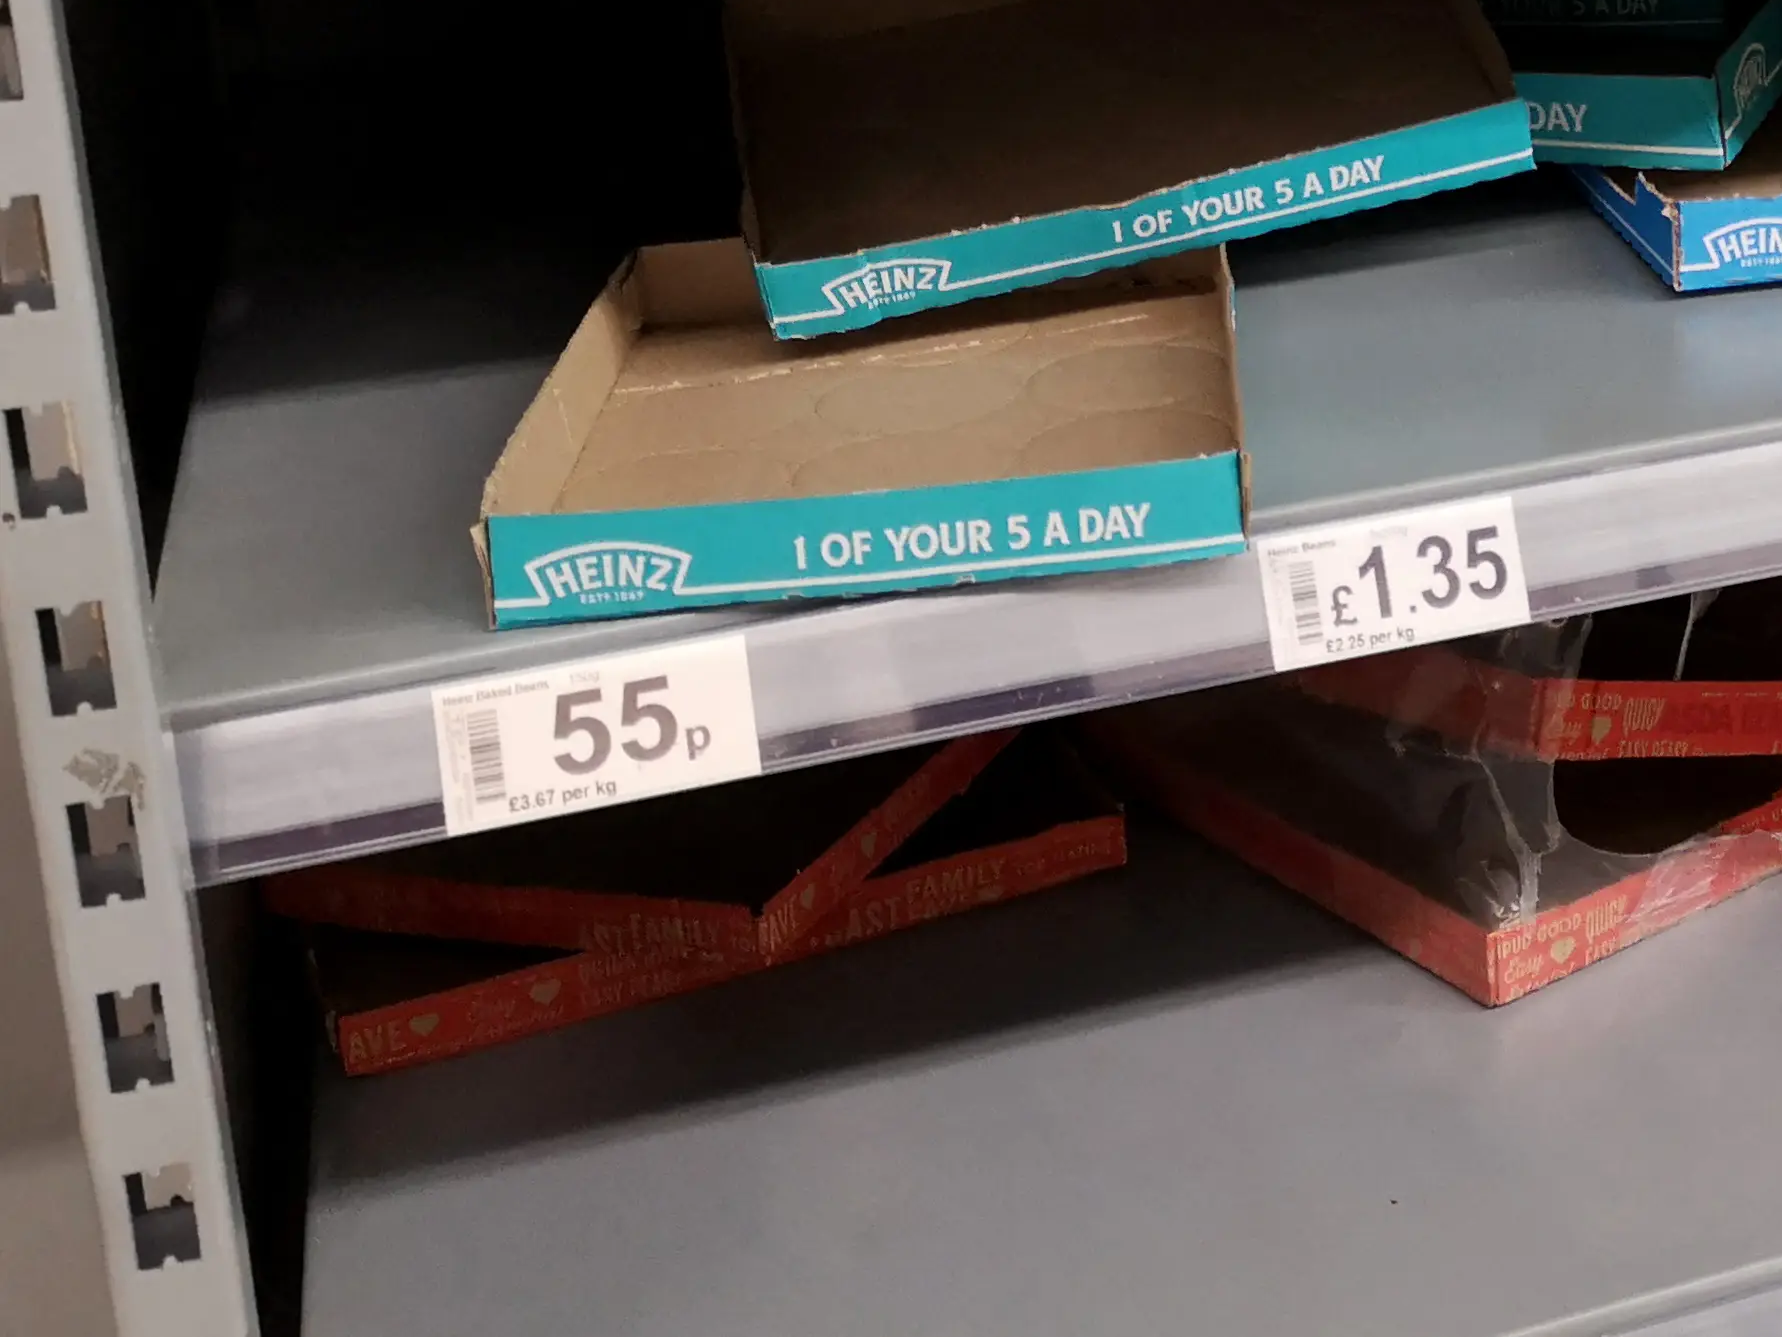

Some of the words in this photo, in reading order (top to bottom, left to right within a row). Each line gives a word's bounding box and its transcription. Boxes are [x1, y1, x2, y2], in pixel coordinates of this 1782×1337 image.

[1530, 103, 1588, 133] DAY
[1112, 219, 1125, 243] 1
[1131, 207, 1175, 240] OF
[1180, 184, 1265, 230] YOUR
[1274, 177, 1294, 207] 5
[1302, 169, 1326, 200] A
[1328, 154, 1387, 192] DAY
[842, 264, 940, 310] HEINZ
[792, 535, 808, 571] 1
[820, 530, 874, 568] OF
[883, 520, 994, 563] YOUR
[1006, 516, 1031, 552] 5
[1042, 512, 1071, 548] A
[1077, 502, 1152, 544] DAY
[550, 554, 672, 596] HEINZ
[1331, 525, 1509, 628] £1.35
[1369, 629, 1393, 649] per
[1395, 626, 1416, 643] kg
[552, 674, 712, 777] 55p
[508, 789, 555, 813] £3.67
[562, 784, 590, 806] per
[595, 779, 617, 797] kg
